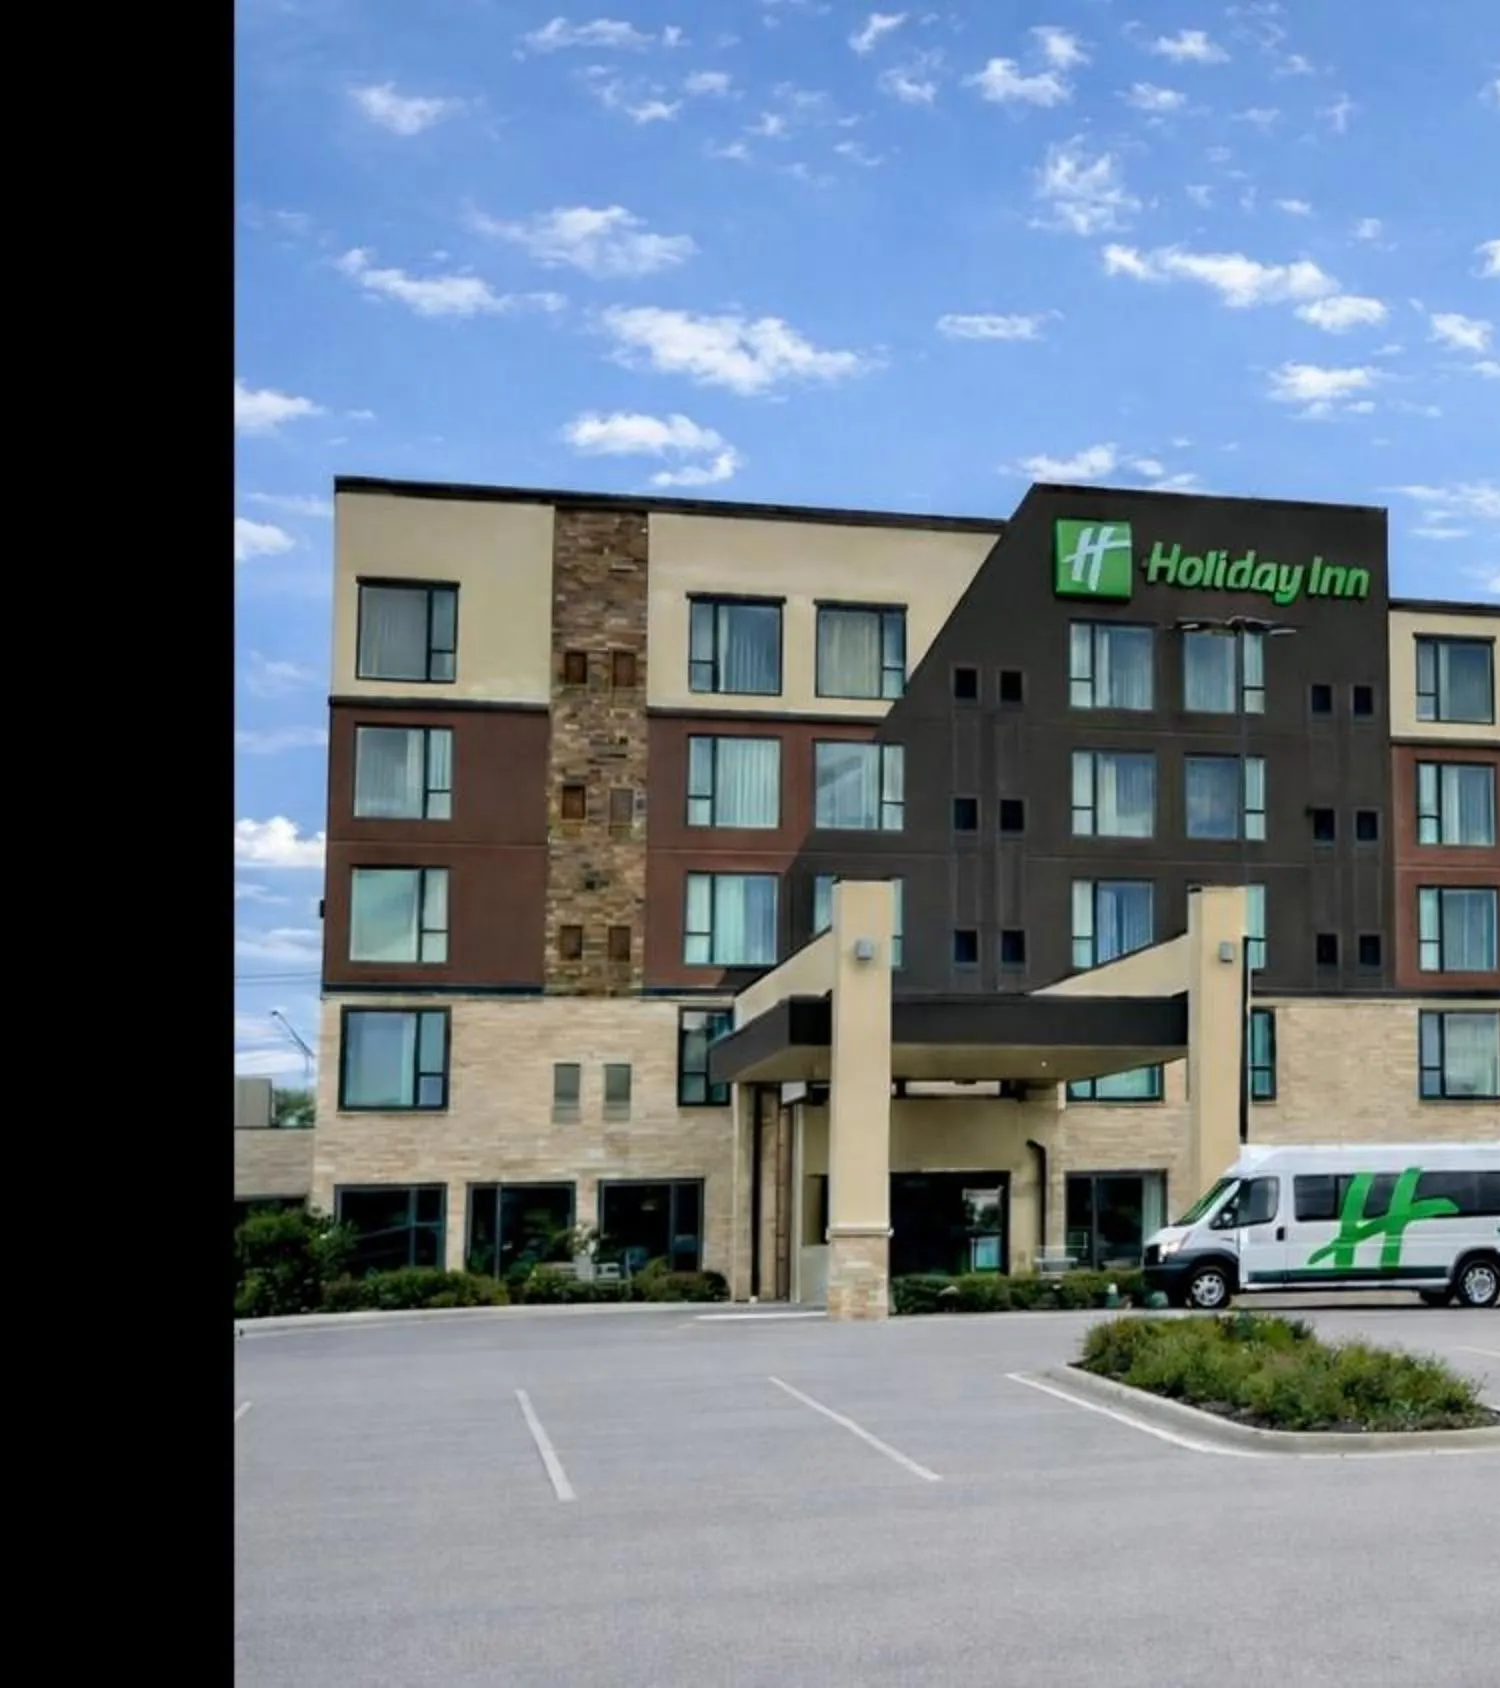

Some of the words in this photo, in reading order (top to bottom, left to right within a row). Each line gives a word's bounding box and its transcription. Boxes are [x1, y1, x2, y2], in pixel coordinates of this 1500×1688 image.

[1062, 525, 1132, 592] H
[1146, 541, 1301, 605] Holiday
[1308, 557, 1370, 597] Inn
[1307, 1167, 1459, 1269] H
